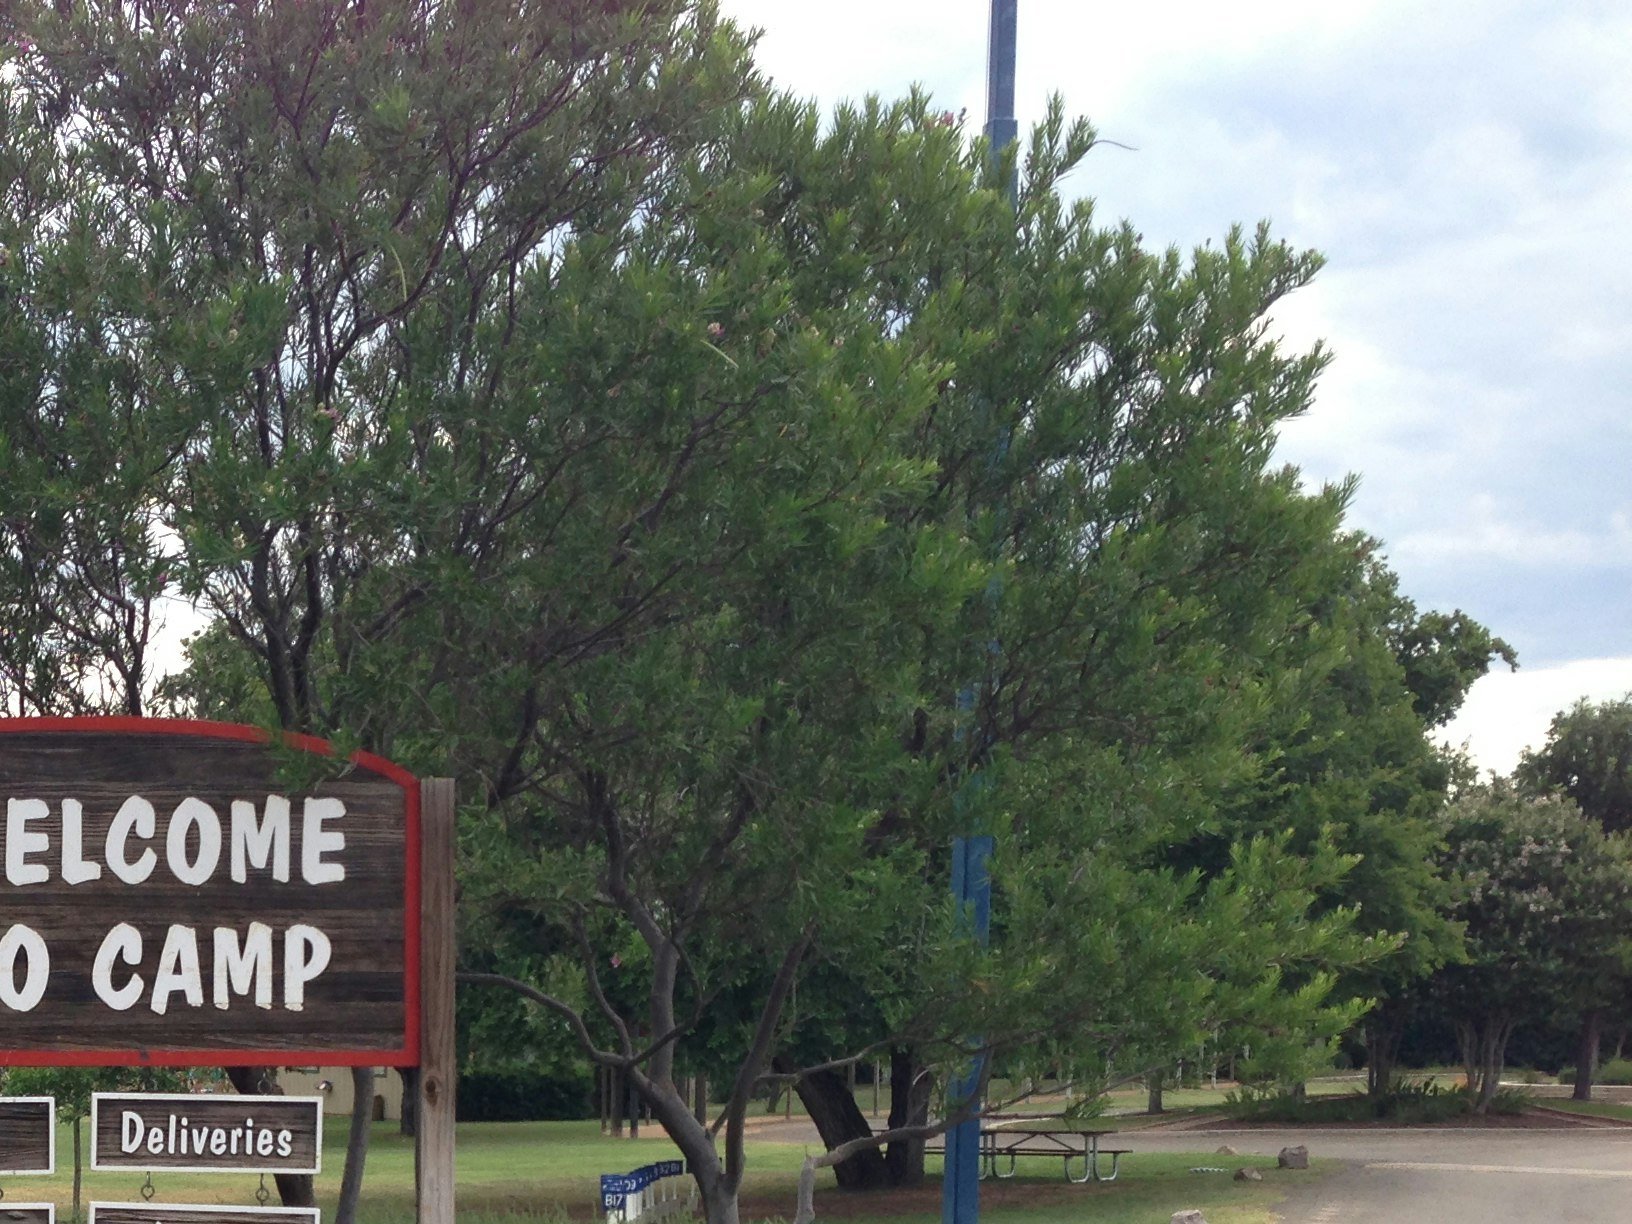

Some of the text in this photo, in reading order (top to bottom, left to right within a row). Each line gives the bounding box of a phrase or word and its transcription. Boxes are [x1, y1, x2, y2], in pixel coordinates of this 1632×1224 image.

[91, 920, 333, 1015] CAMP
[120, 1110, 294, 1158] Deliveries
[605, 1193, 623, 1206] B17
